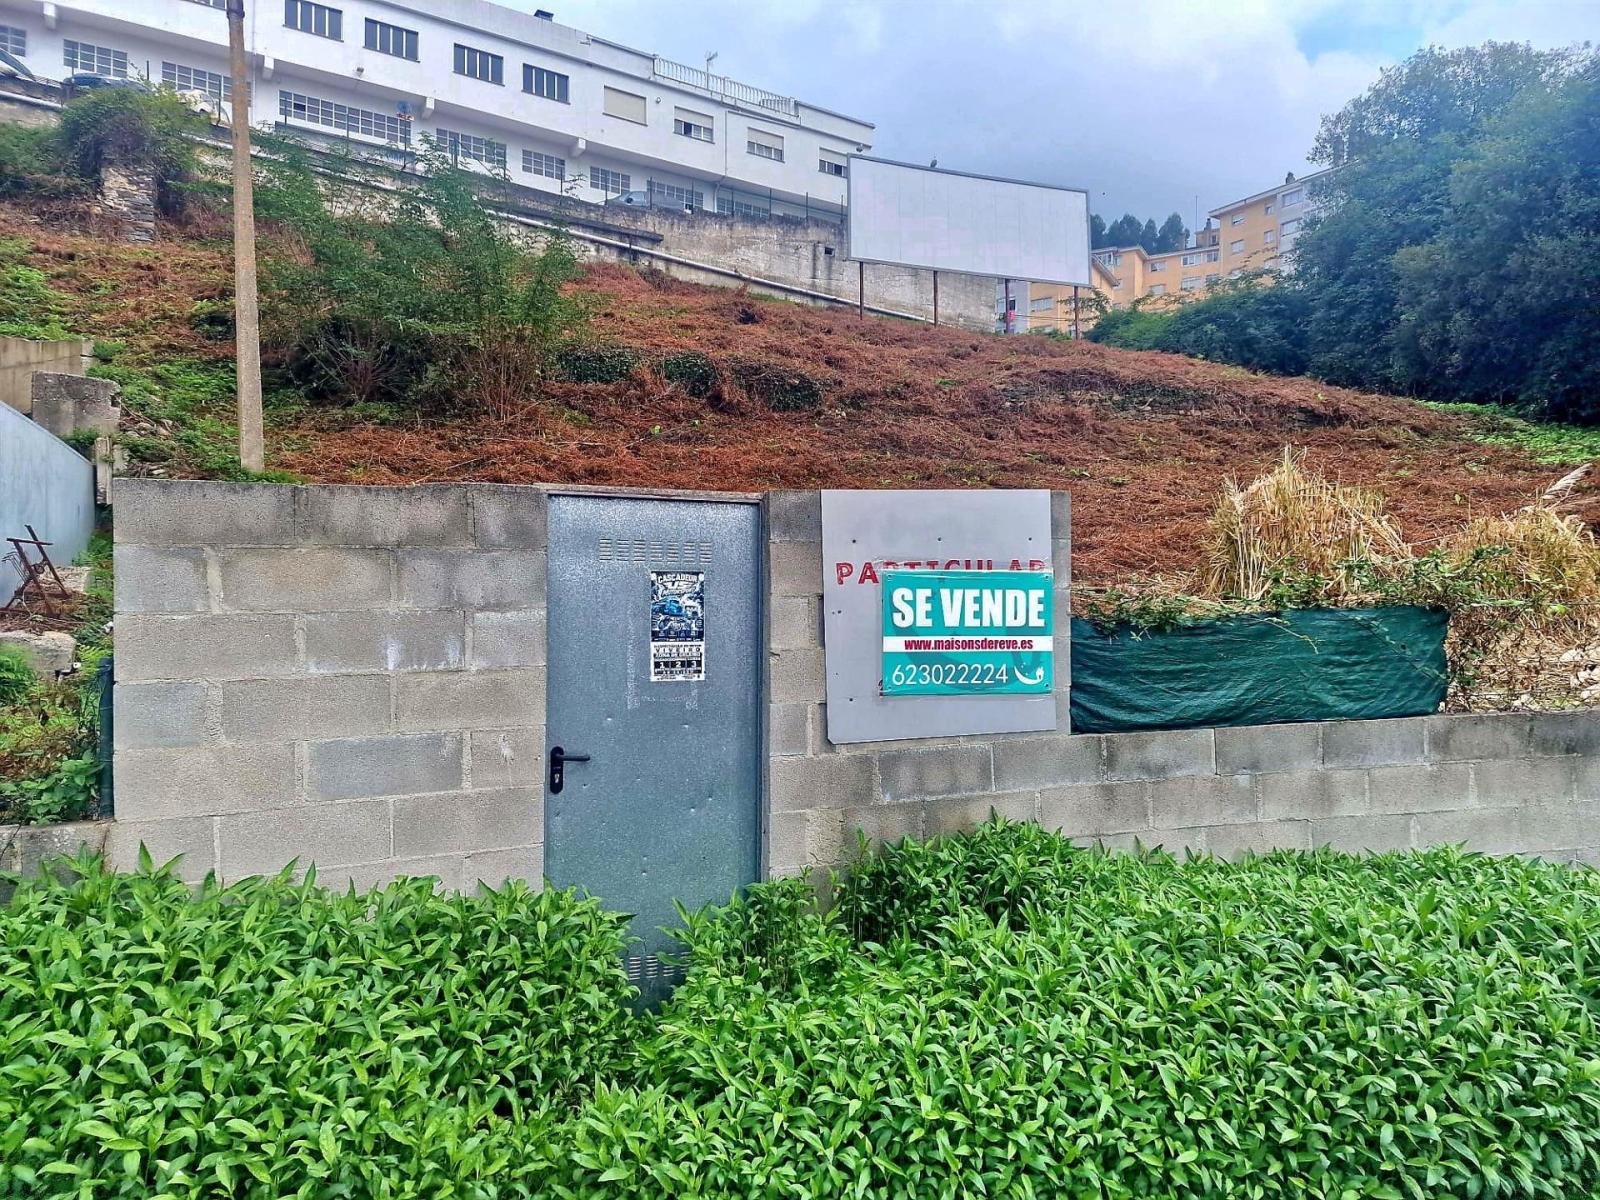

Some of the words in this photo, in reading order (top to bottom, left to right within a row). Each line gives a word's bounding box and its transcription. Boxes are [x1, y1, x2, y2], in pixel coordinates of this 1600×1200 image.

[658, 573, 698, 583] CASCADEUR
[892, 587, 932, 628] SE
[939, 588, 1045, 628] VENDE
[904, 637, 1033, 651] www.maisonsdereve.es
[892, 663, 1008, 686] 623022224
